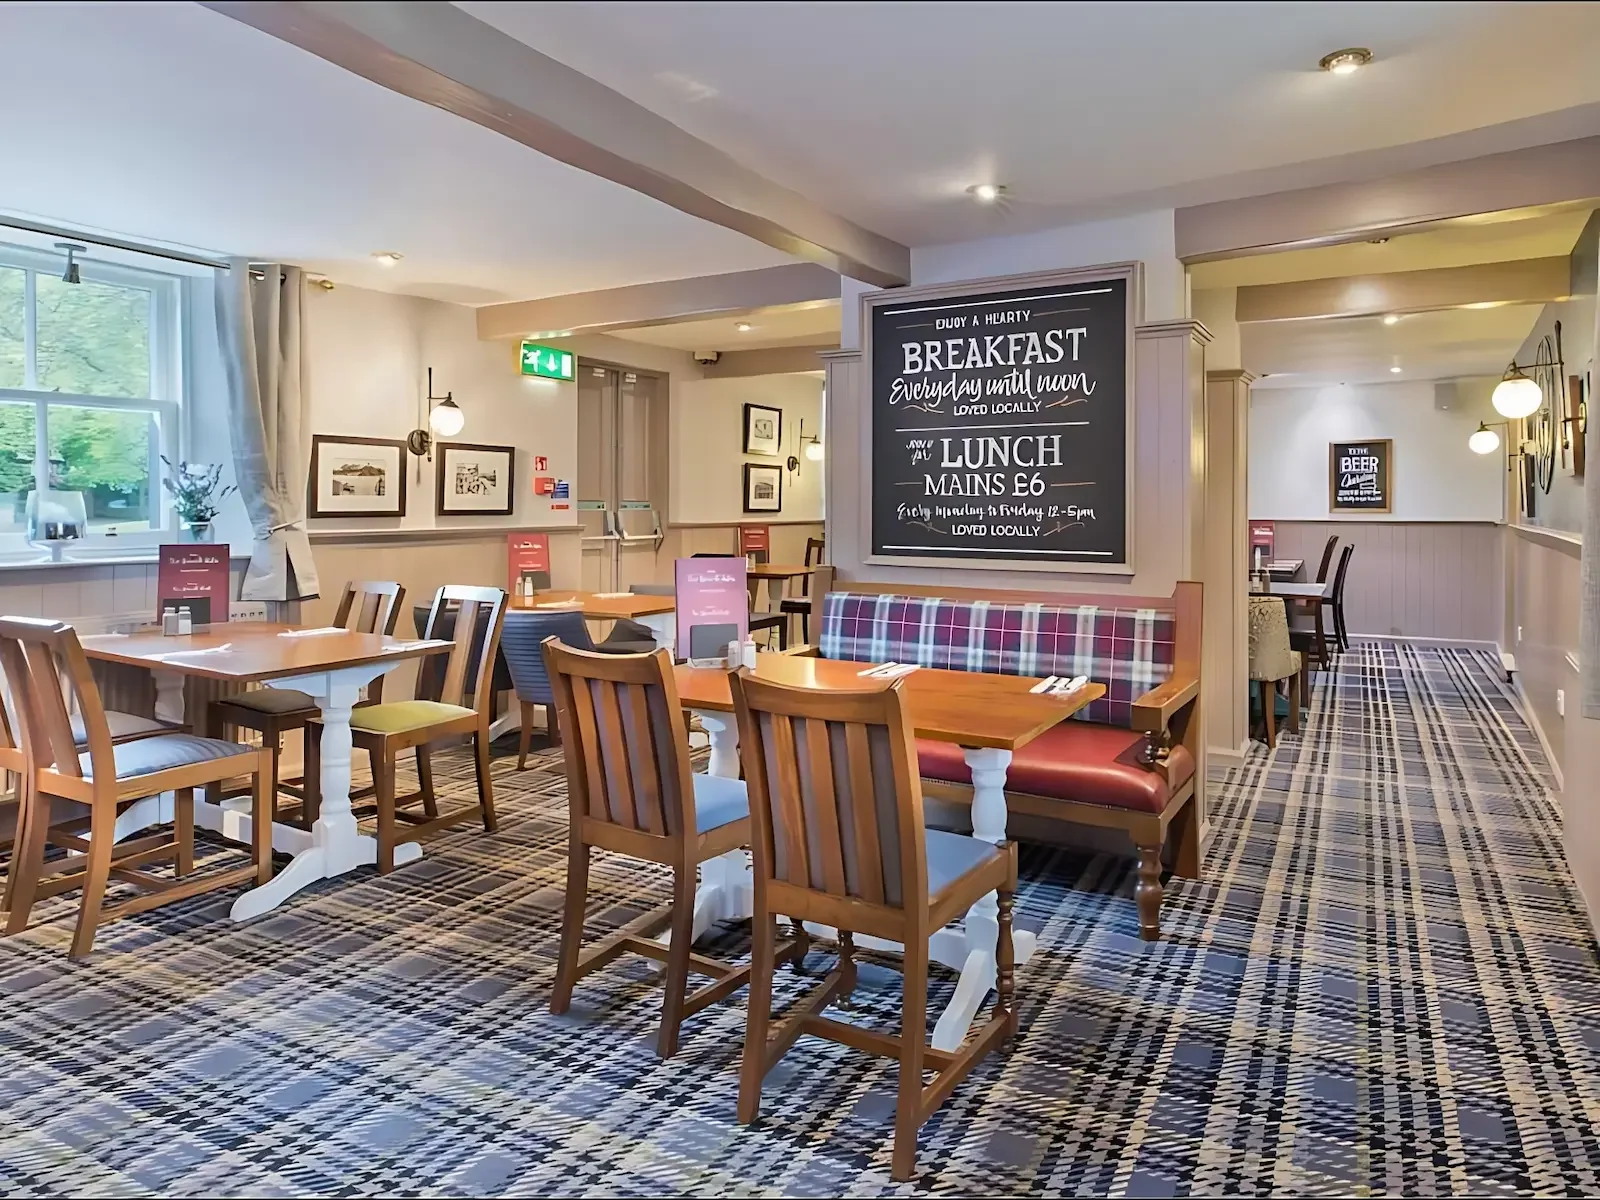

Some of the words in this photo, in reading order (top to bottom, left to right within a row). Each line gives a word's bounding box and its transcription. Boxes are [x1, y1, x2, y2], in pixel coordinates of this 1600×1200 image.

[972, 315, 980, 327] A
[902, 327, 1087, 375] BREAKFAST
[889, 372, 982, 408] Everyday
[985, 368, 1038, 400] until
[1036, 372, 1096, 396] noon
[953, 404, 988, 416] LOVED
[991, 401, 1042, 415] LOCALLY
[940, 435, 1063, 469] LUNCH
[1341, 456, 1379, 474] BEER
[924, 472, 1006, 497] MAINS
[1012, 472, 1046, 497] £6
[952, 524, 987, 536] LOVED
[990, 525, 1040, 537] LOCALLY
